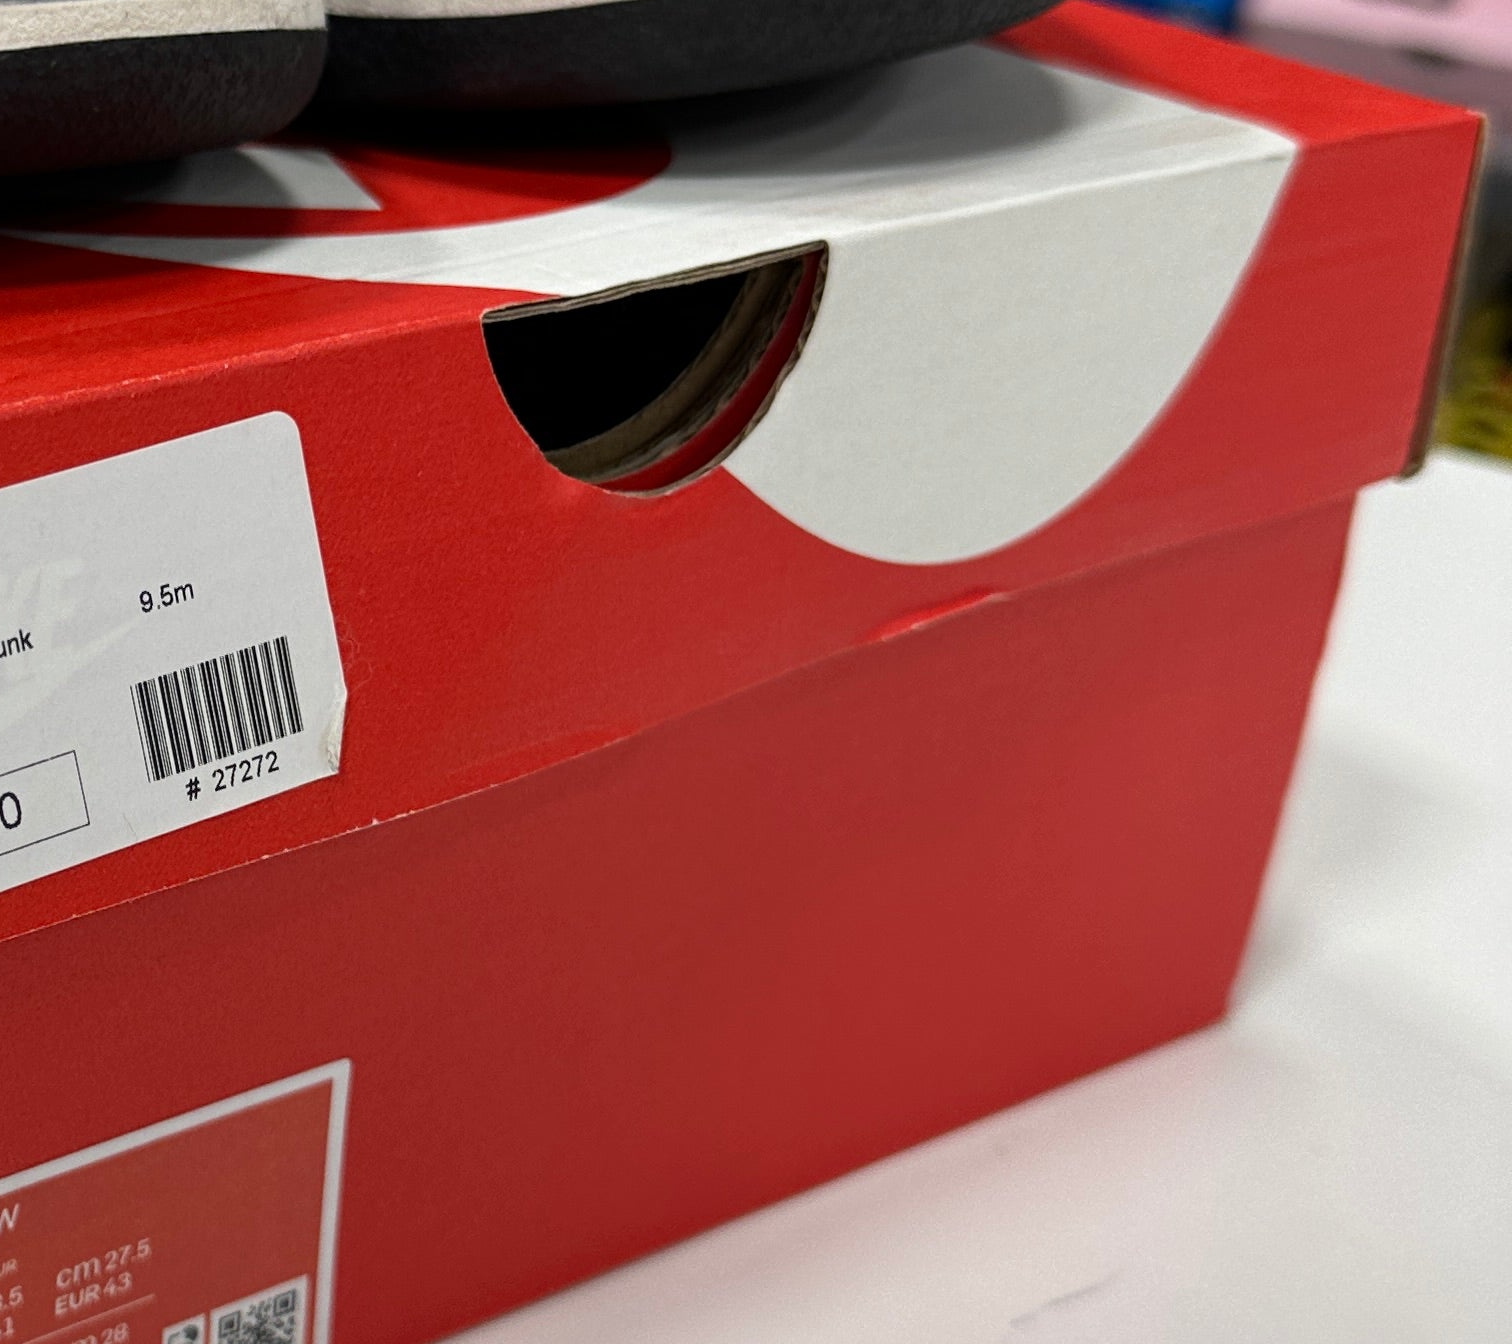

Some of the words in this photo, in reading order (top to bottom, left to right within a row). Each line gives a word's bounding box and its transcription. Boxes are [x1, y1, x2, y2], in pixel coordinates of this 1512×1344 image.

[139, 580, 196, 614] 9.5m
[186, 777, 202, 801] #
[211, 750, 281, 794] 27272
[56, 1257, 102, 1289] cm
[104, 1237, 152, 1272] 27.5
[55, 1283, 101, 1317] EUR
[103, 1271, 133, 1298] 43
